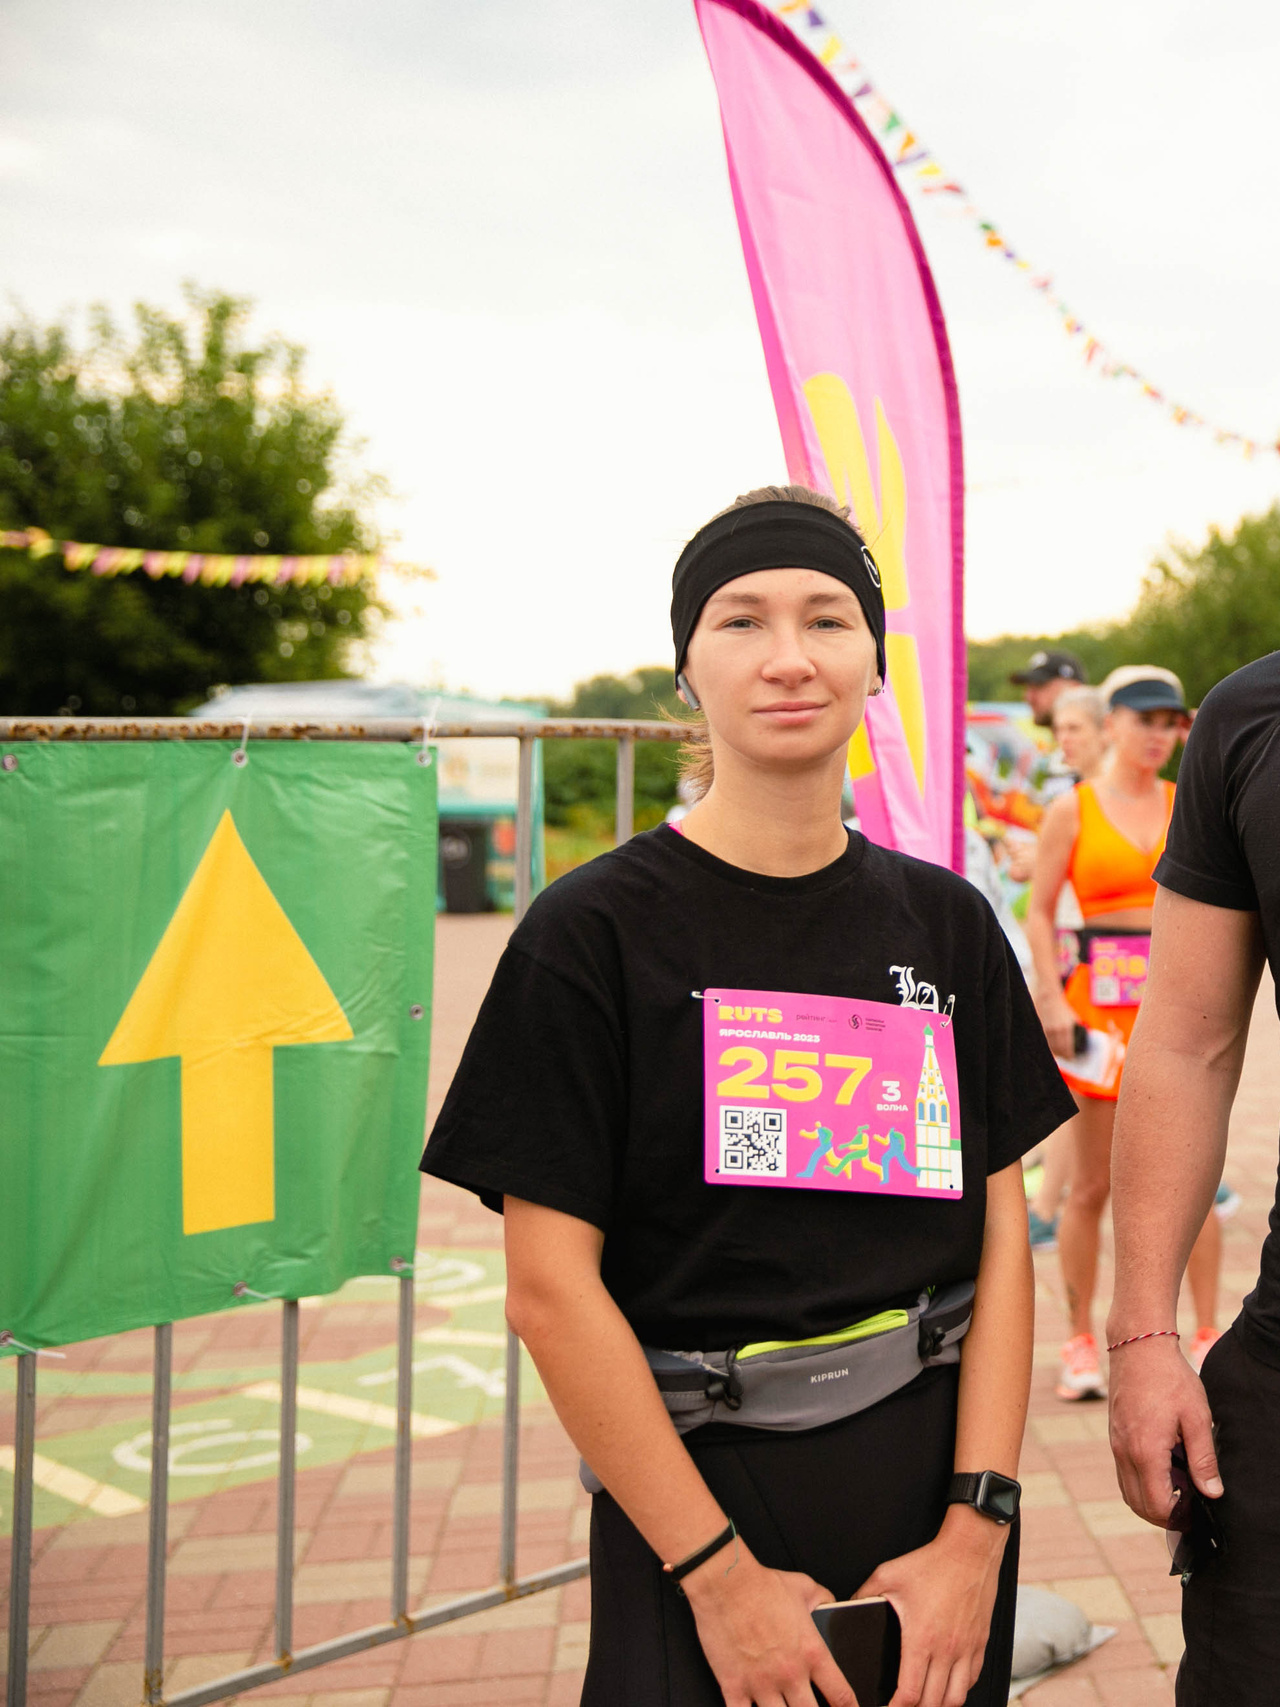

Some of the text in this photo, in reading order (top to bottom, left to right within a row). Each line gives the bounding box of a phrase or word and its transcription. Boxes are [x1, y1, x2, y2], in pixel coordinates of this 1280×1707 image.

[718, 1005, 783, 1024] RUTS
[719, 1028, 820, 1043] ЯРОСЛАВЛЬ 2023
[716, 1046, 873, 1106] 257
[881, 1080, 901, 1102] 3
[876, 1103, 909, 1112] ВОЛНА
[810, 1368, 849, 1384] KIPRUN
